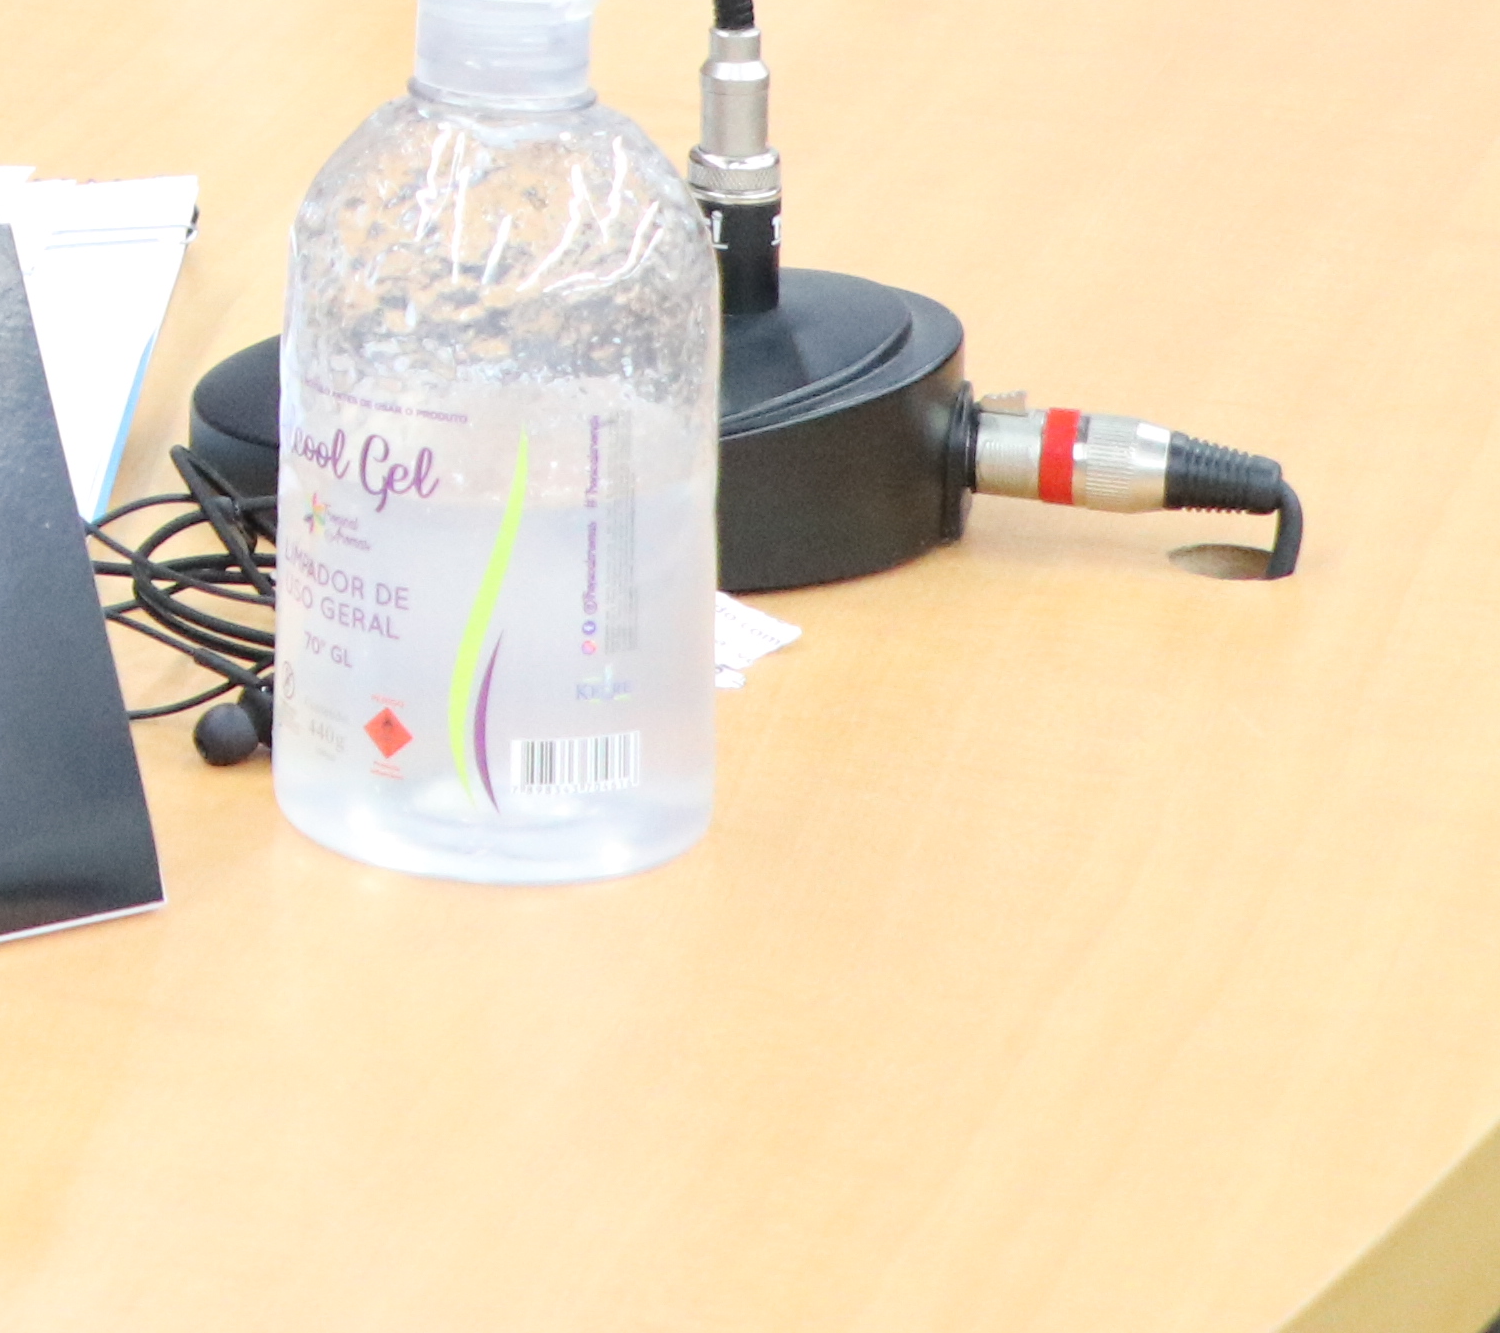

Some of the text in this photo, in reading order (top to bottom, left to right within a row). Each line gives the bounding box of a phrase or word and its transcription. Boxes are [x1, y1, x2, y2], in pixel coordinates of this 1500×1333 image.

[359, 434, 440, 513] Gel
[376, 582, 410, 611] DE
[321, 596, 400, 641] GERAL
[331, 645, 353, 669] GL
